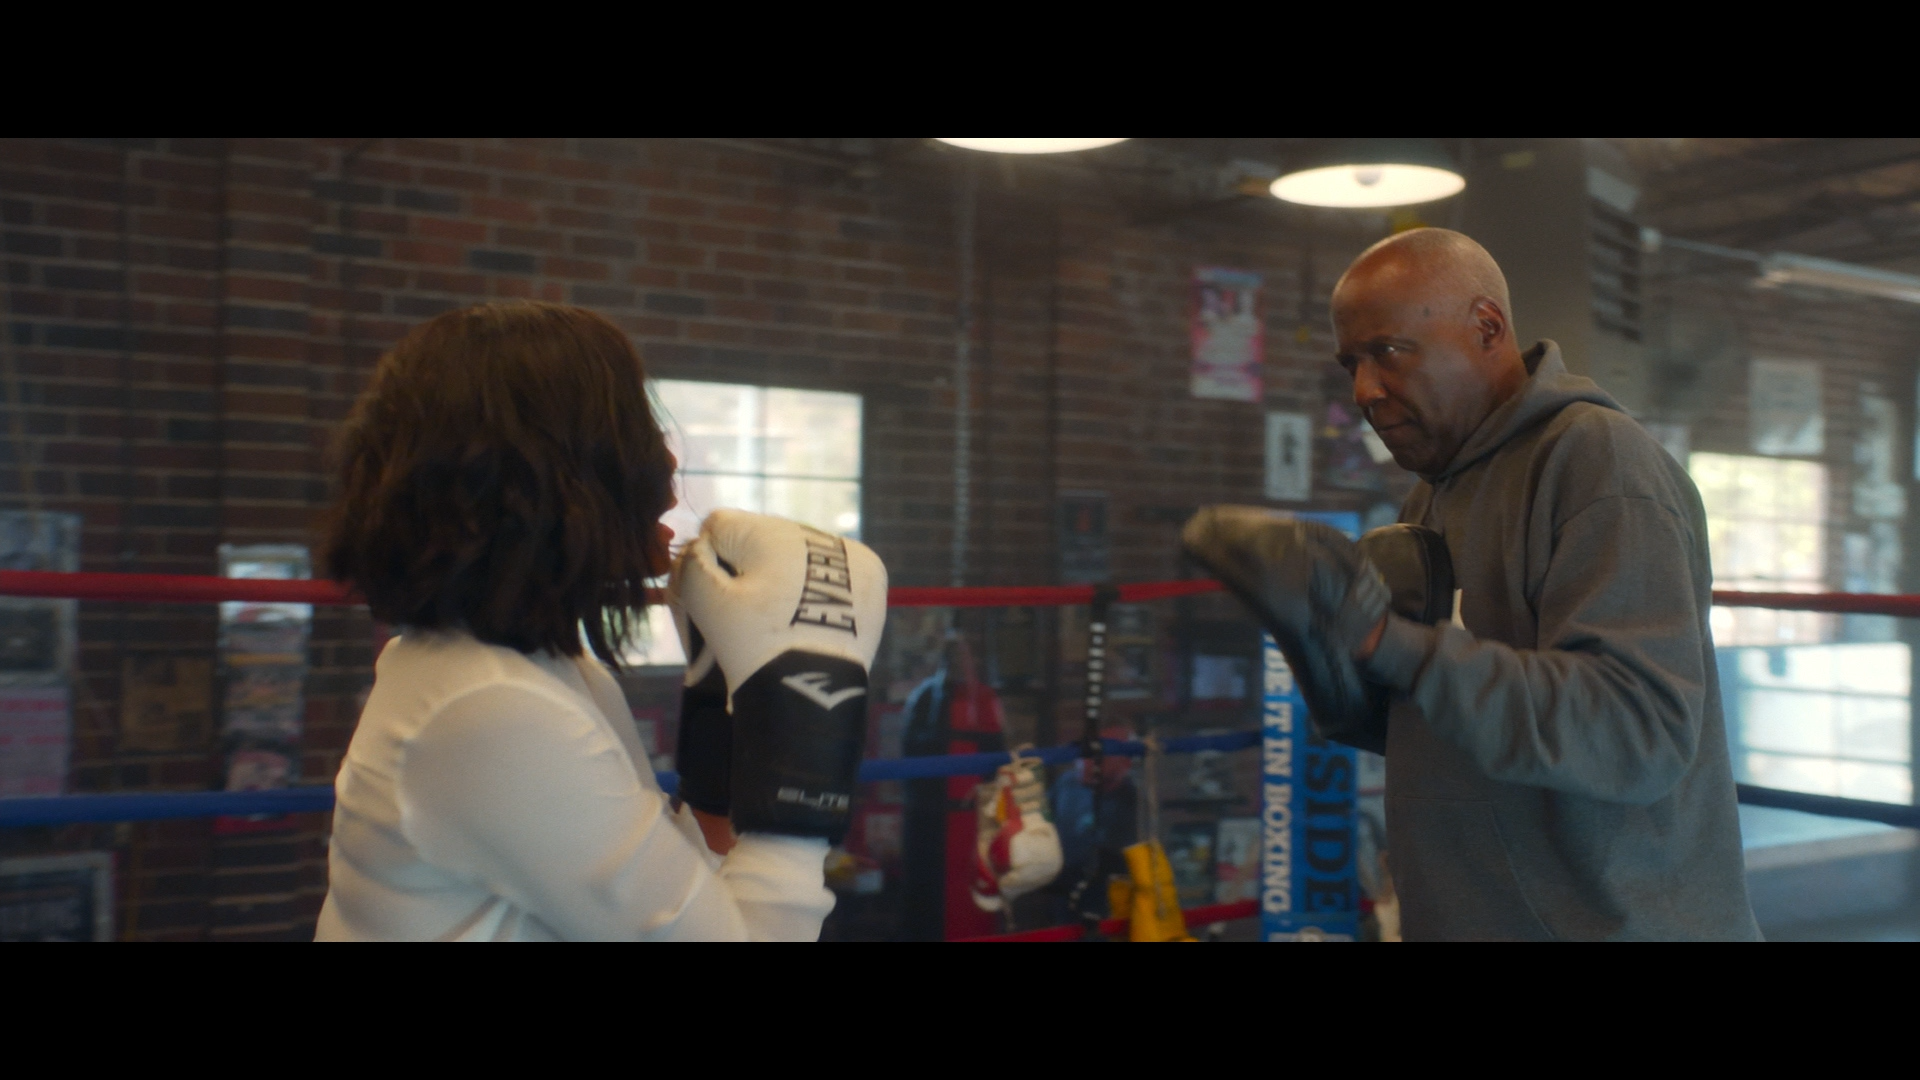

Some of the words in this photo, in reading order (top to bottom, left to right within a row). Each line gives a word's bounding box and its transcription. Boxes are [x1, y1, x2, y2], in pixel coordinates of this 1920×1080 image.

[1263, 738, 1293, 777] IN
[1262, 784, 1293, 914] BOXING
[1305, 735, 1352, 912] SIDE
